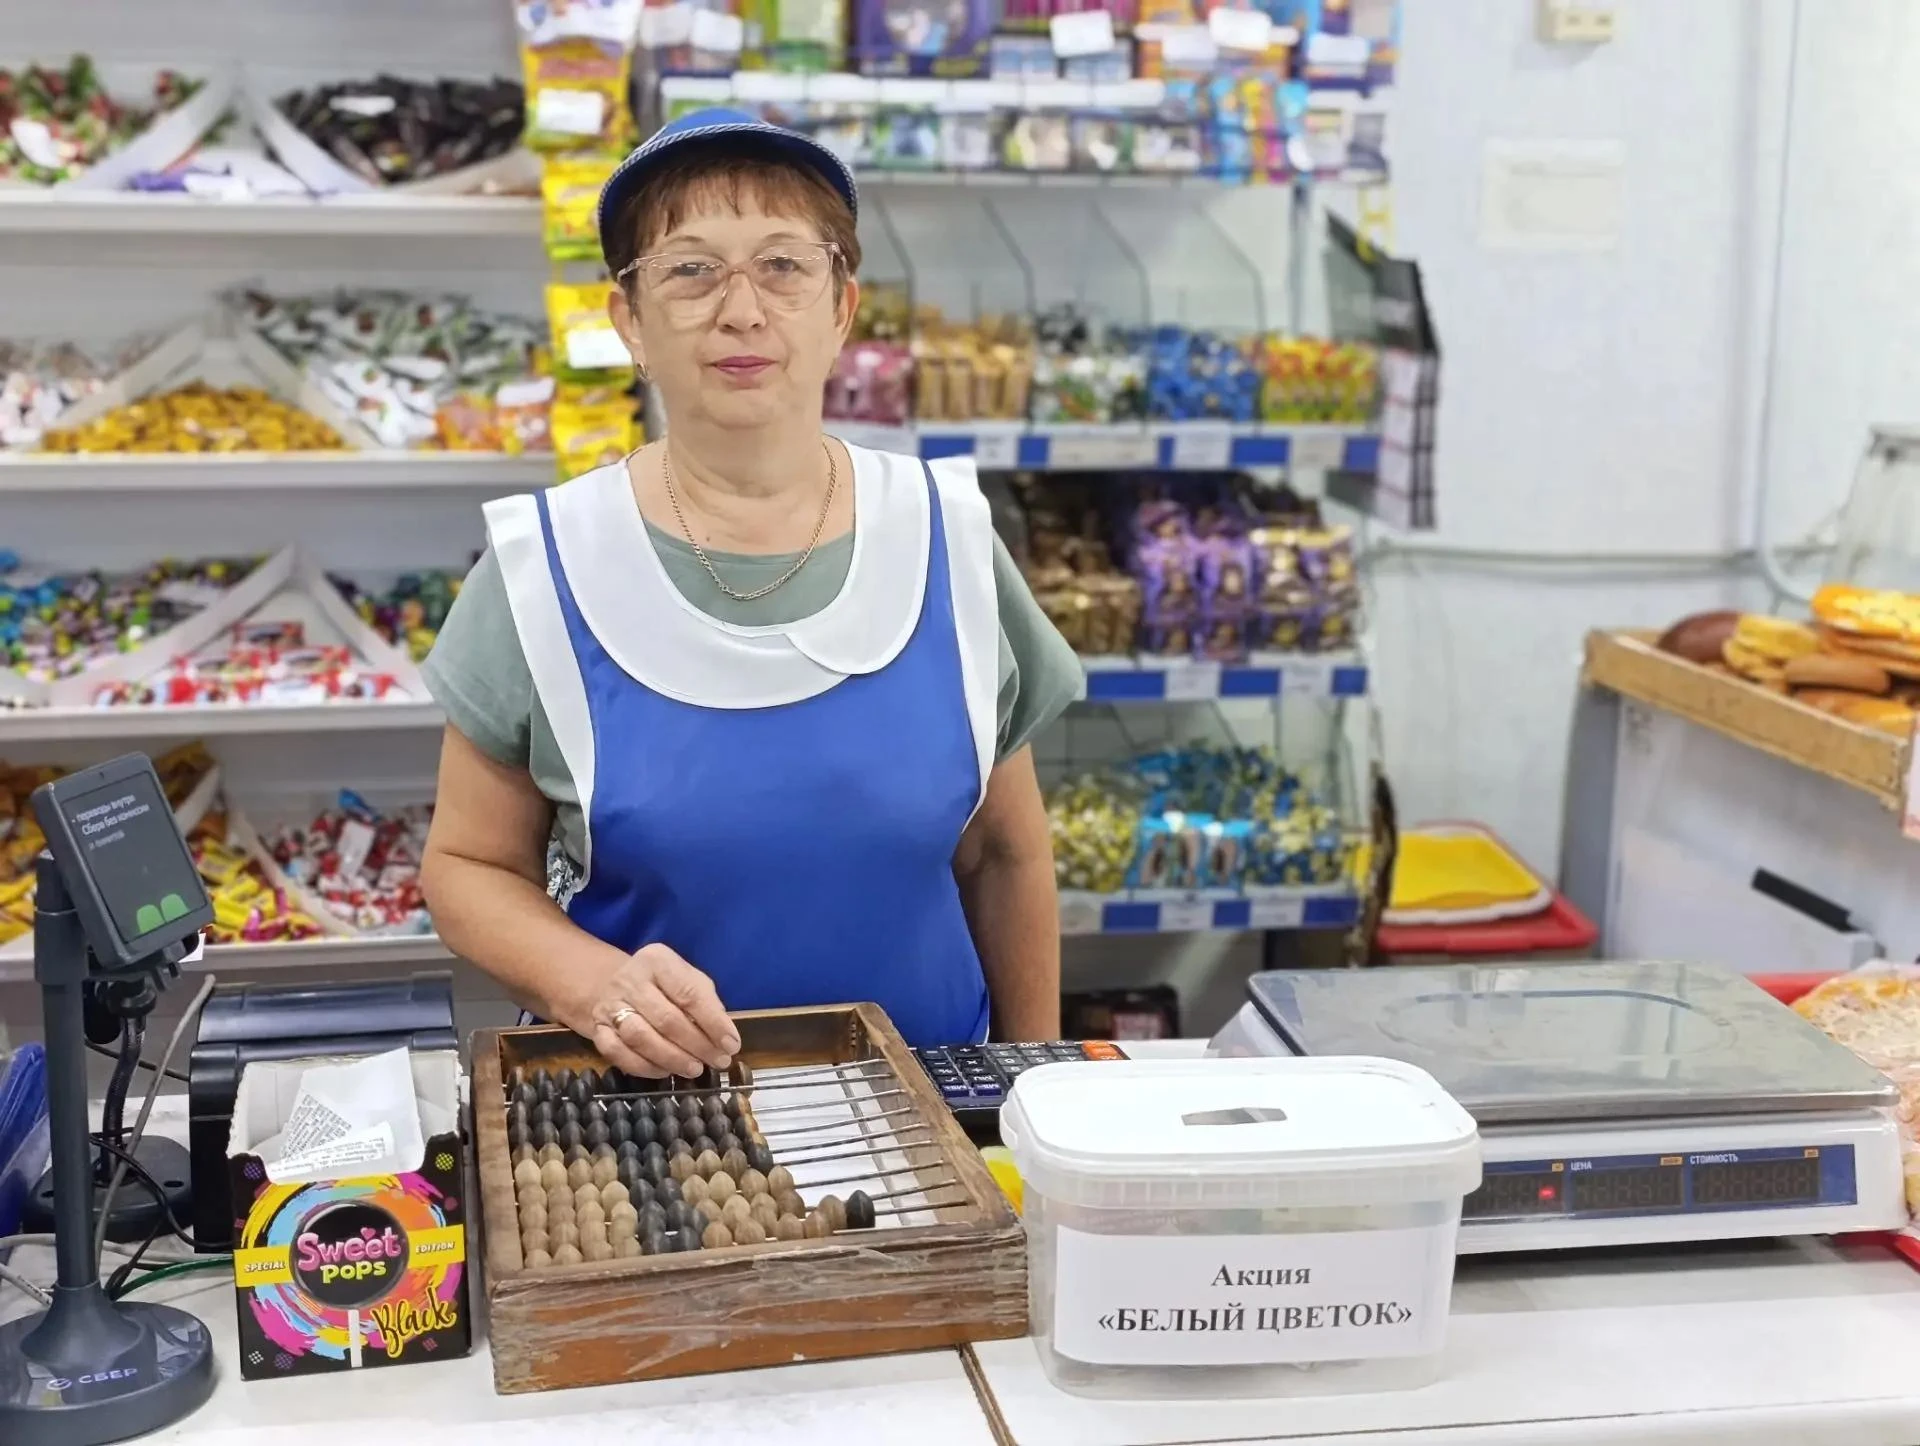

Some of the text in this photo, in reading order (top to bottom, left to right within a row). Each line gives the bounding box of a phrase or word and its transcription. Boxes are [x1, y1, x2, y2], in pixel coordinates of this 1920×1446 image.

[1570, 1161, 1593, 1172] ЦЕНА
[1689, 1153, 1739, 1165] СТОИМОСТЬ
[297, 1227, 402, 1272] Sweet
[415, 1241, 455, 1254] EDITION
[244, 1260, 286, 1273] SPECIAL
[1211, 1264, 1311, 1288] Акция
[371, 1285, 457, 1358] Black
[1098, 1301, 1412, 1334] «БЕЛЫЙ ЦВЕТОК»
[78, 1367, 139, 1385] СБЕР
